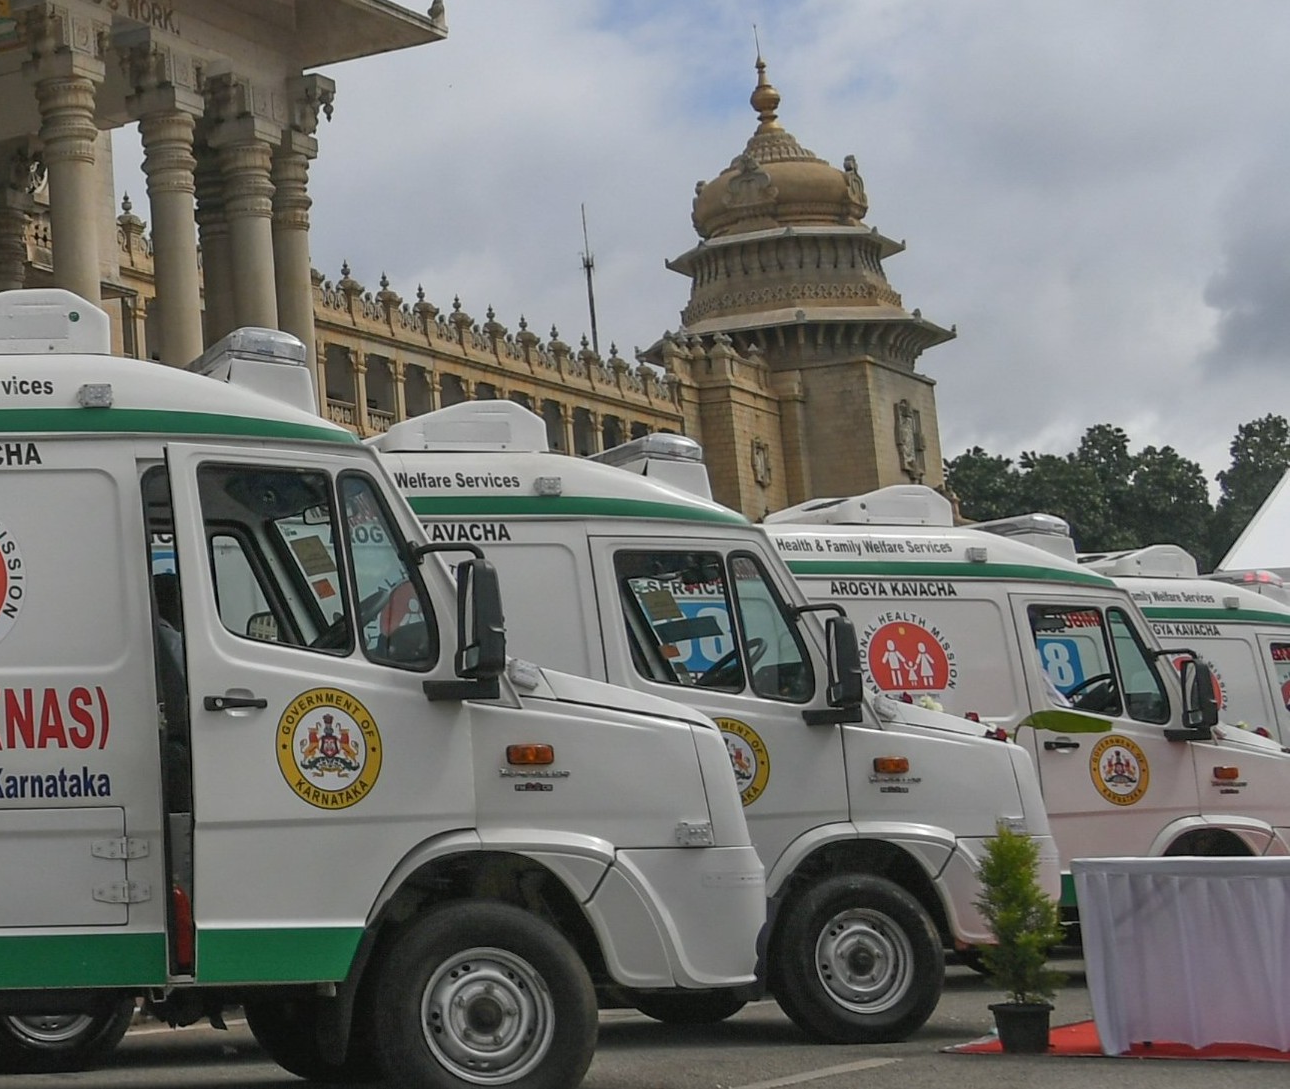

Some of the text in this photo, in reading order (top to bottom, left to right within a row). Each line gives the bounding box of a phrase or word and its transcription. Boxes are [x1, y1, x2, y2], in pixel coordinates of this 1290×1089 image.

[394, 472, 520, 489] Welfare Services
[775, 538, 953, 555] Health & Family Welfare Services
[830, 581, 957, 596] AROGYA KAVACHA
[1131, 591, 1215, 604] amily Welfare Services
[1153, 624, 1220, 636] GYA KAVACHA
[878, 612, 925, 627] HEALTH
[931, 627, 957, 689] MISSION
[282, 693, 374, 737] GOVERNMENT OF
[295, 778, 369, 806] KARNATAKA
